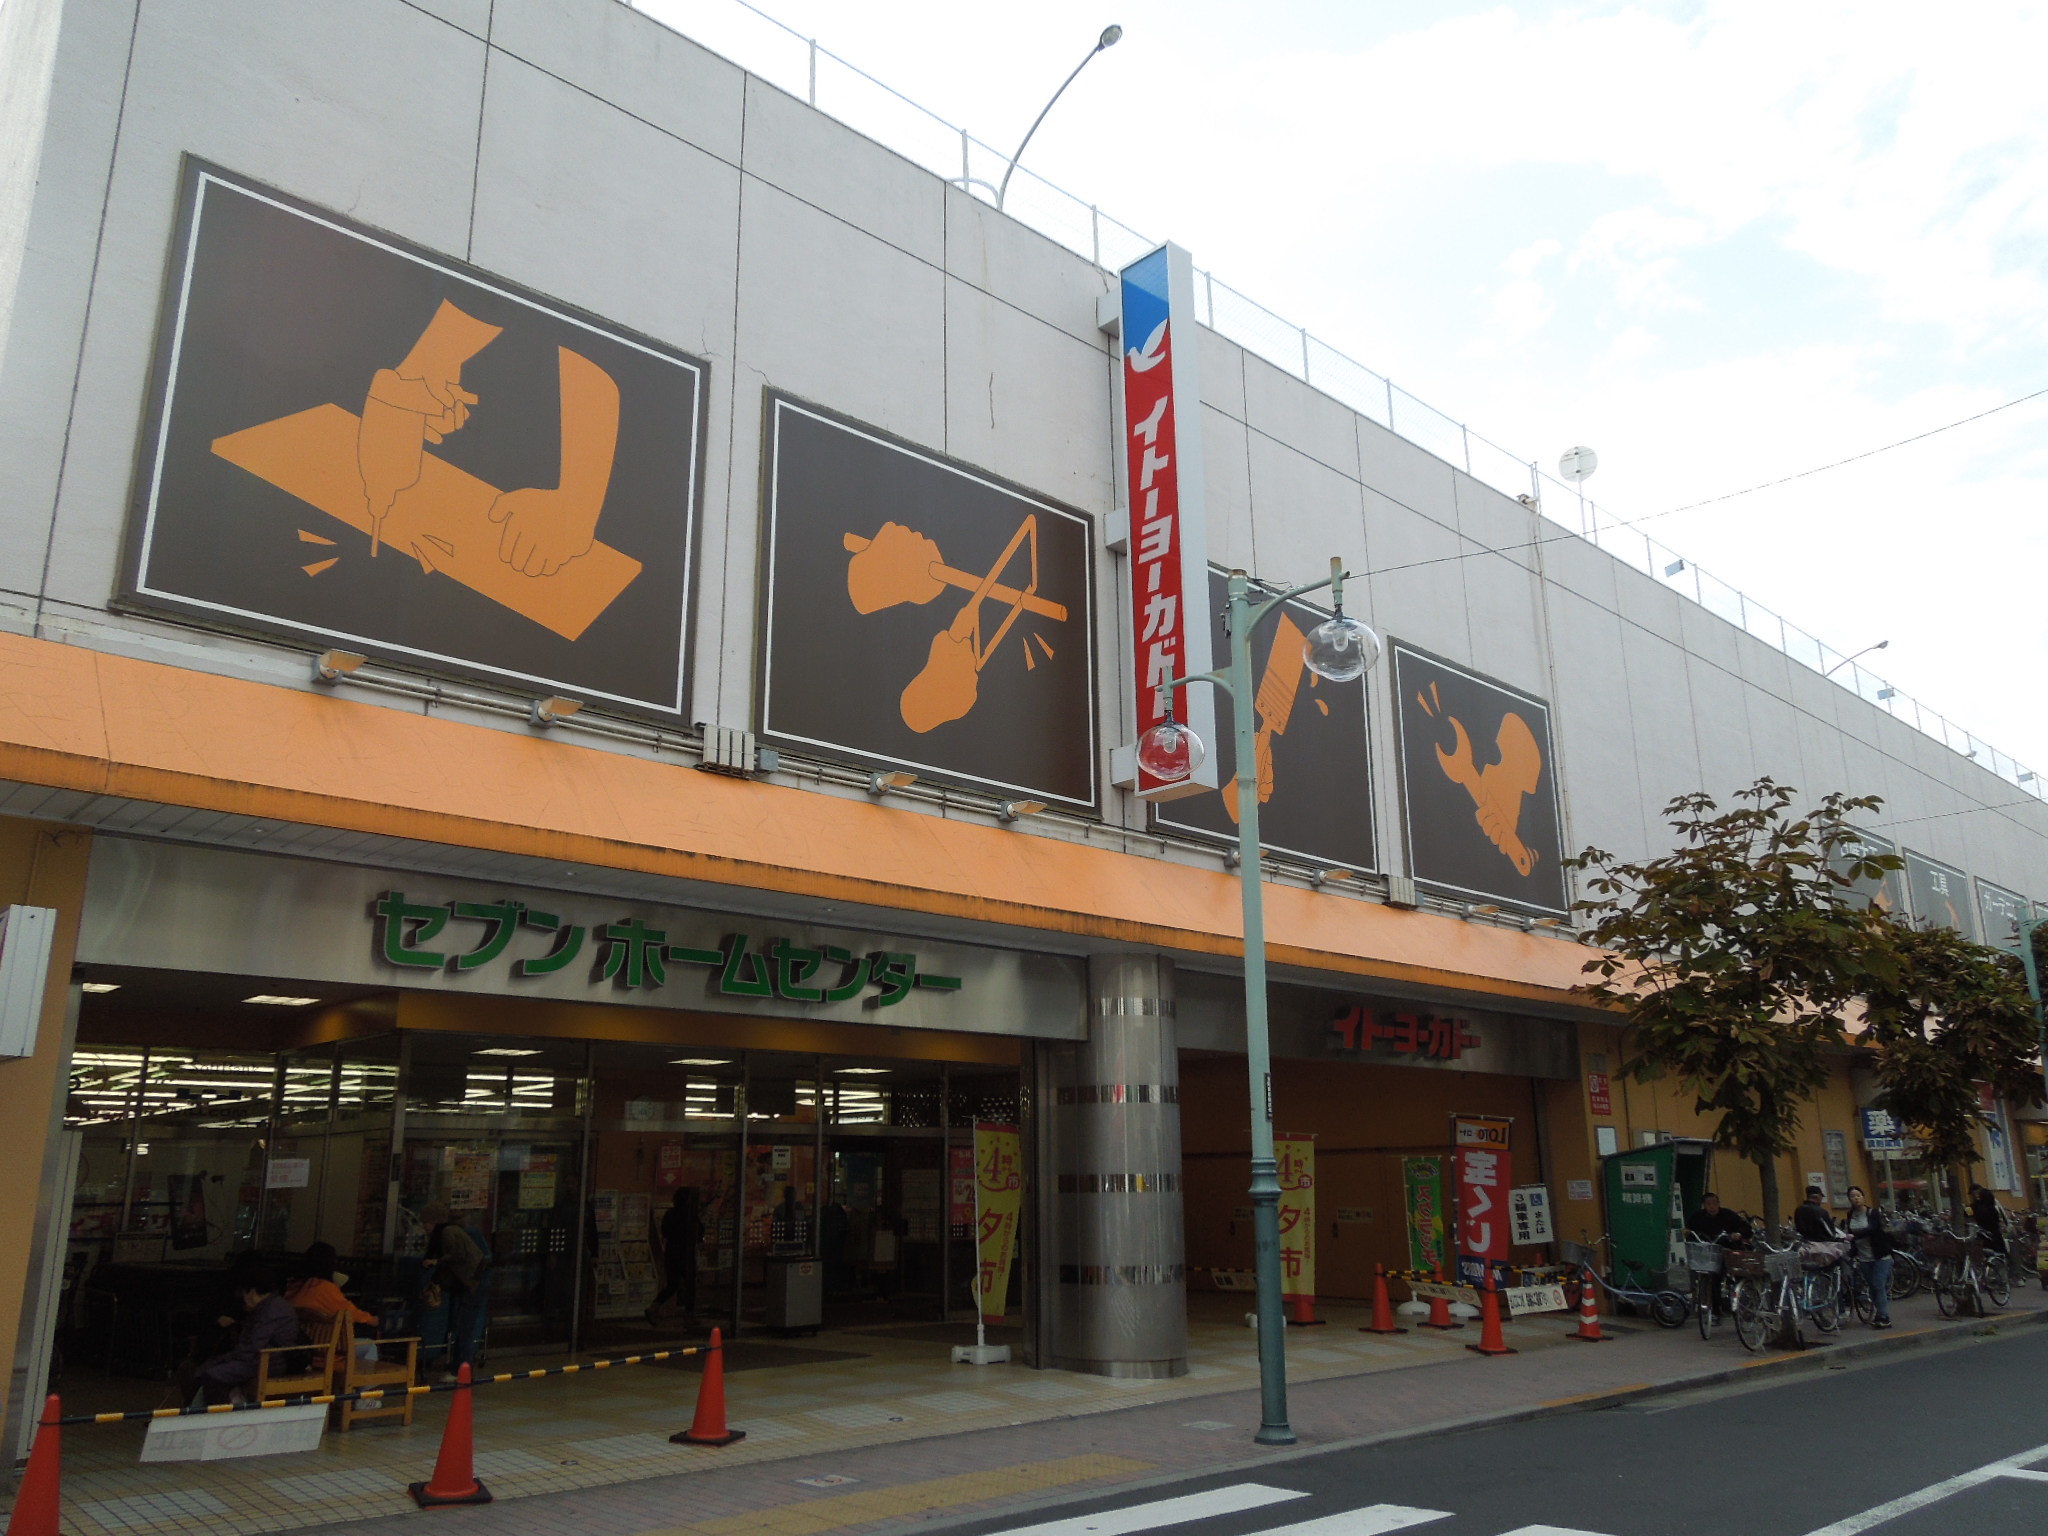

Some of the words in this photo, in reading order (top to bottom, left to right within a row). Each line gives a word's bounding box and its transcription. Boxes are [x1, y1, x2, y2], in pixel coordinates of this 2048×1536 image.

[1334, 1005, 1481, 1059] イトーヨーカドー
[1867, 1109, 1897, 1136] 薬
